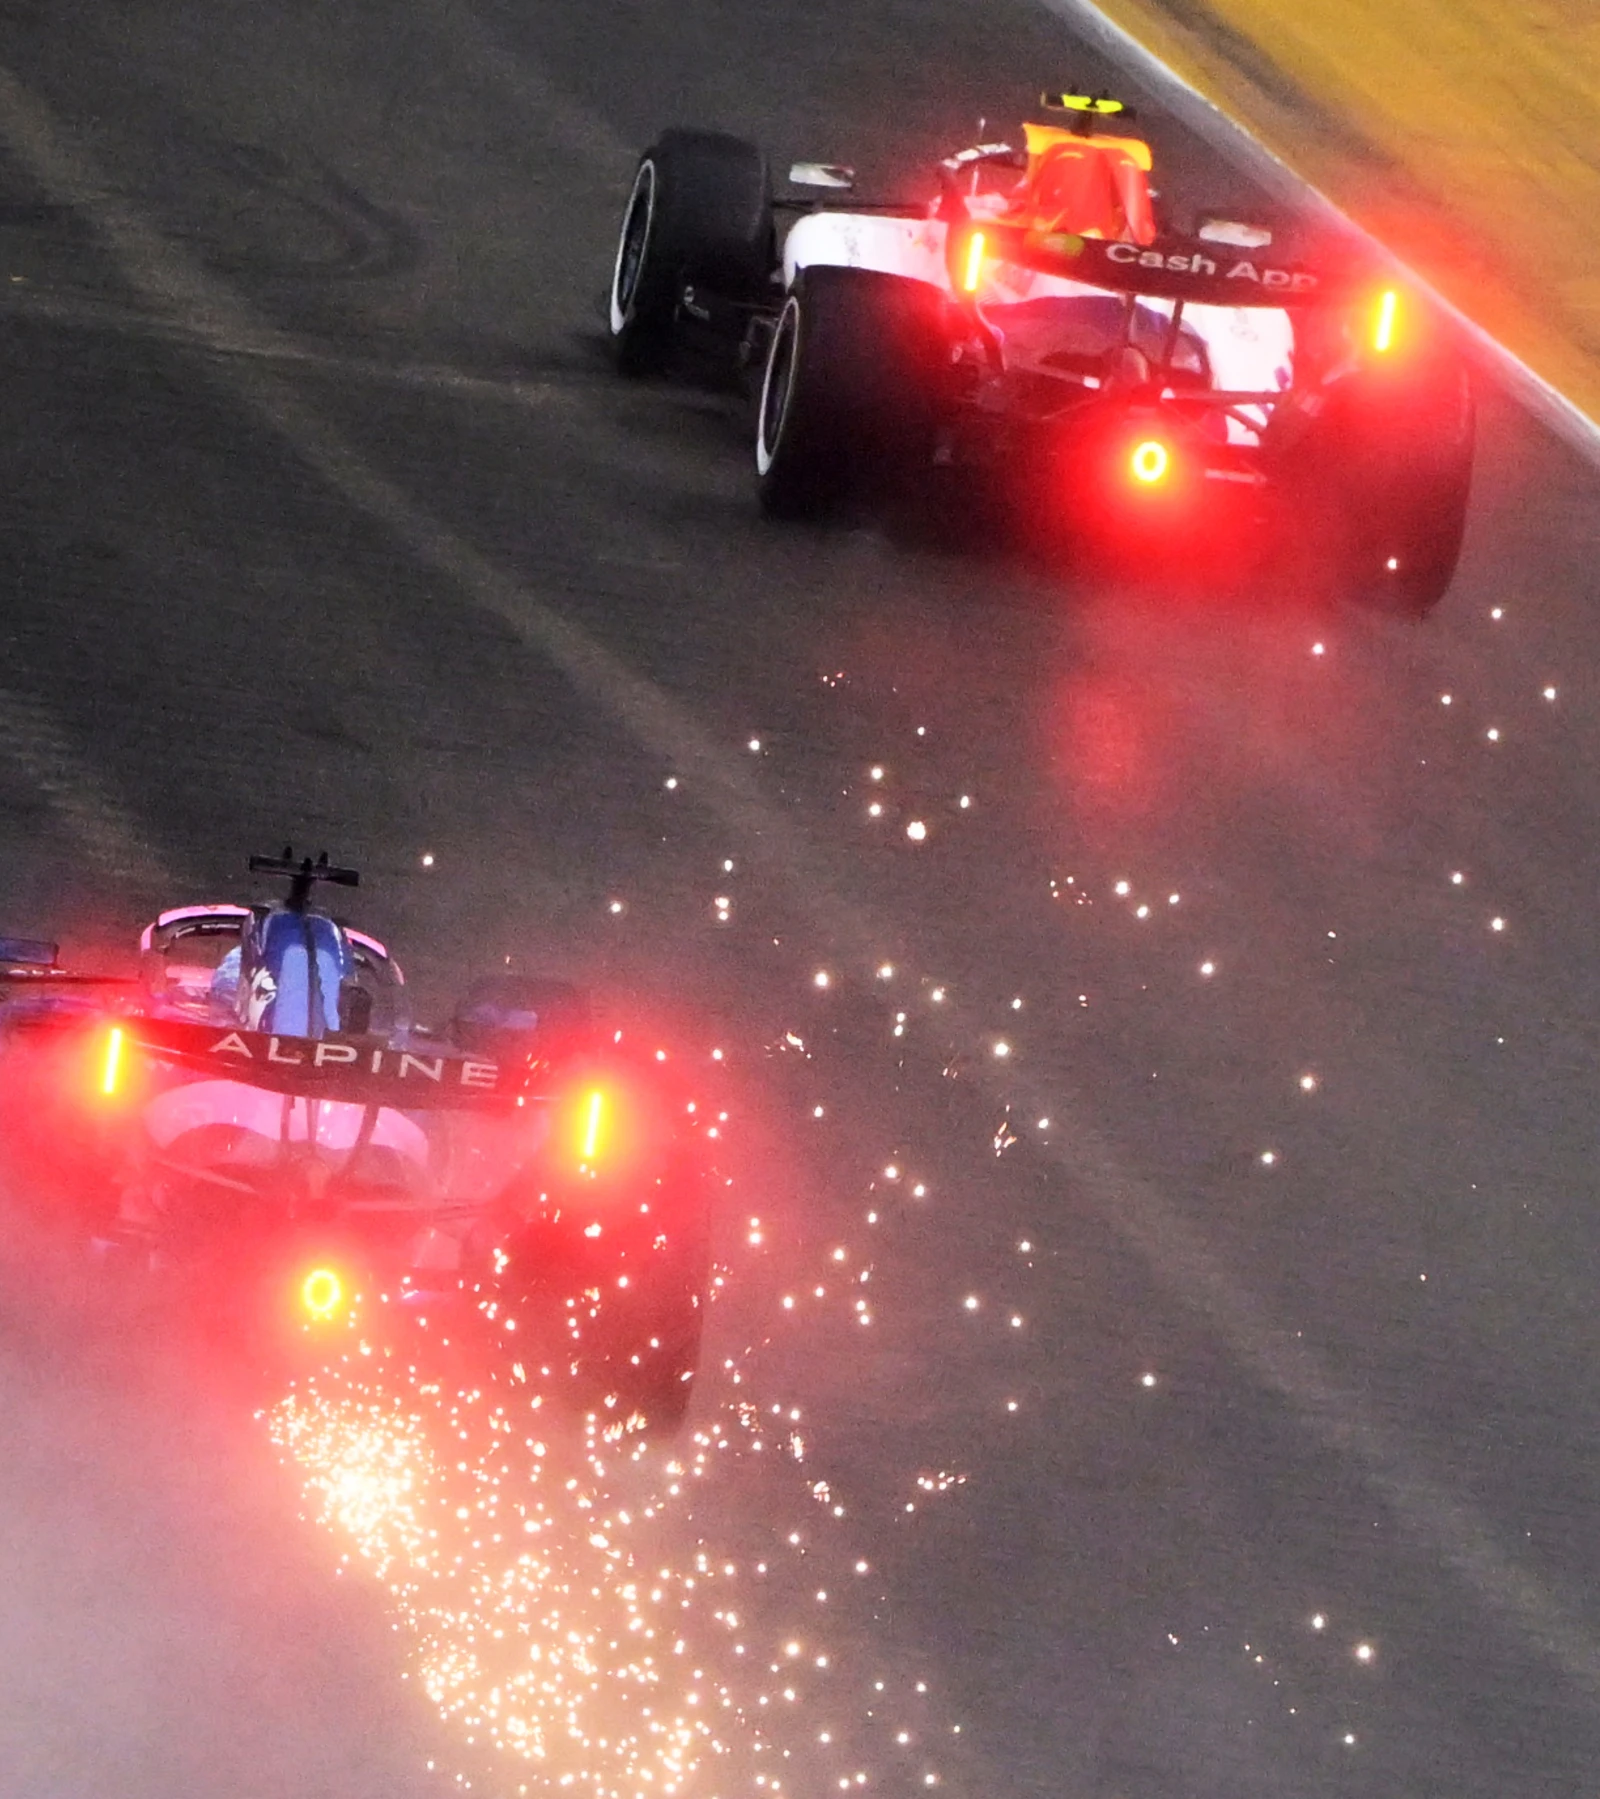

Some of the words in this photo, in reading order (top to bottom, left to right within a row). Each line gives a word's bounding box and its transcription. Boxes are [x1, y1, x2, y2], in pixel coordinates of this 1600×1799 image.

[1105, 243, 1216, 276] Cash
[1225, 261, 1319, 291] App
[208, 1032, 499, 1088] ALPINE
